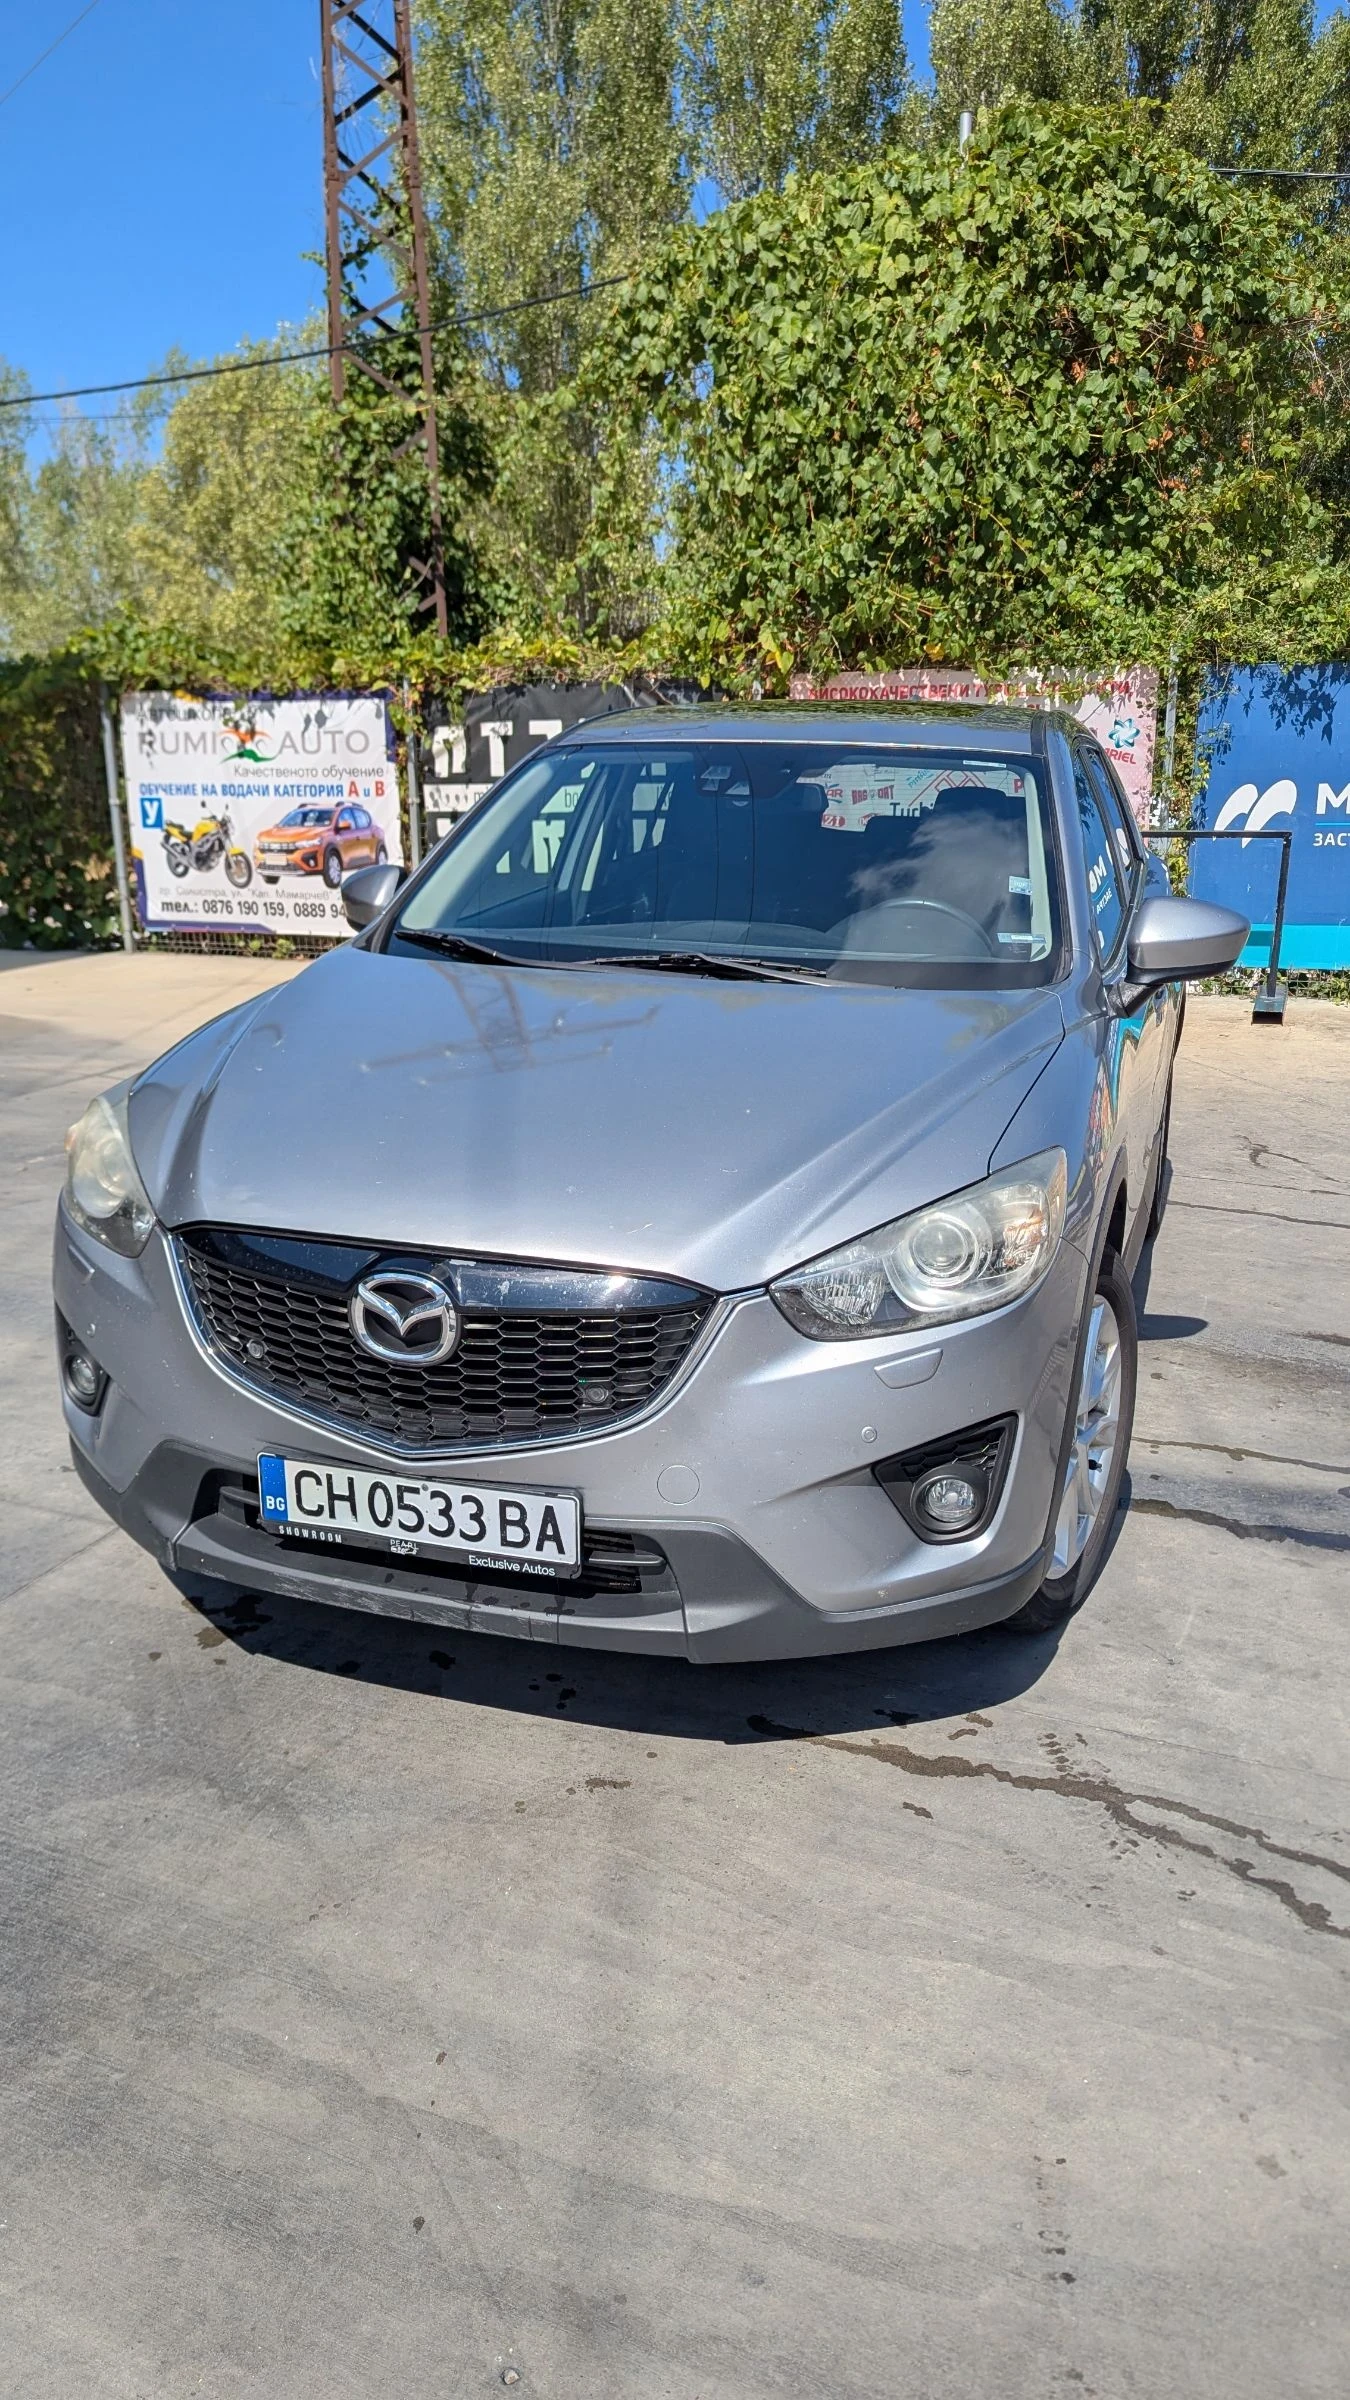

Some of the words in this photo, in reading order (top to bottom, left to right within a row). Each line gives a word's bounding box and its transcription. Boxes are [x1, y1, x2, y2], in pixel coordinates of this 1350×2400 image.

[139, 731, 217, 755] RUMI
[280, 730, 370, 755] AUTO
[234, 766, 318, 778] Качественото
[322, 764, 384, 781] обучение
[139, 783, 197, 797] ОБУЧЕНИЕ
[201, 784, 218, 797] НА
[221, 784, 270, 799] ВОДАЧИ
[274, 785, 344, 798] КАТЕГОРИЯ
[202, 899, 233, 915] 0876
[237, 900, 259, 916] 190
[262, 901, 289, 918] 159,
[293, 902, 326, 918] 0889
[265, 1496, 286, 1512] BG
[278, 1525, 342, 1544] SHOWROOM
[468, 1555, 520, 1572] Exclusive
[522, 1563, 555, 1576] Autos
